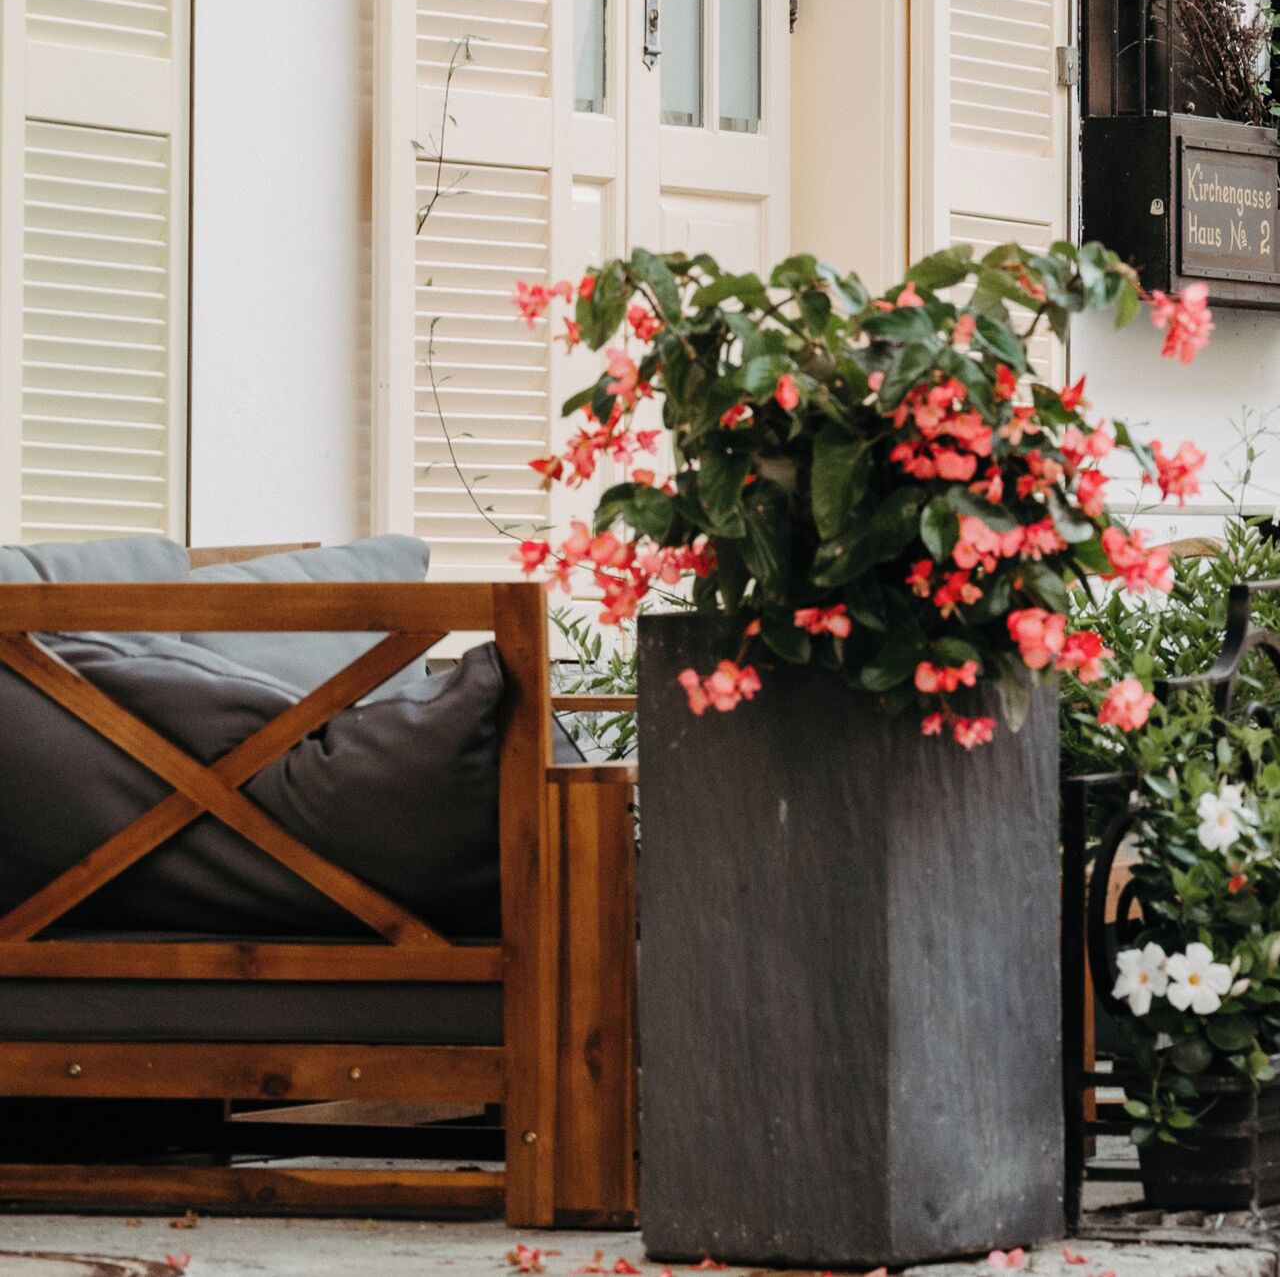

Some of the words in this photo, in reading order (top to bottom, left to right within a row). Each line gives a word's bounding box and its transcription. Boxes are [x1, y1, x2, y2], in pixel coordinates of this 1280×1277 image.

[1186, 162, 1272, 217] Kirchengasse
[1187, 209, 1222, 248] Haus
[1260, 219, 1271, 255] 2
